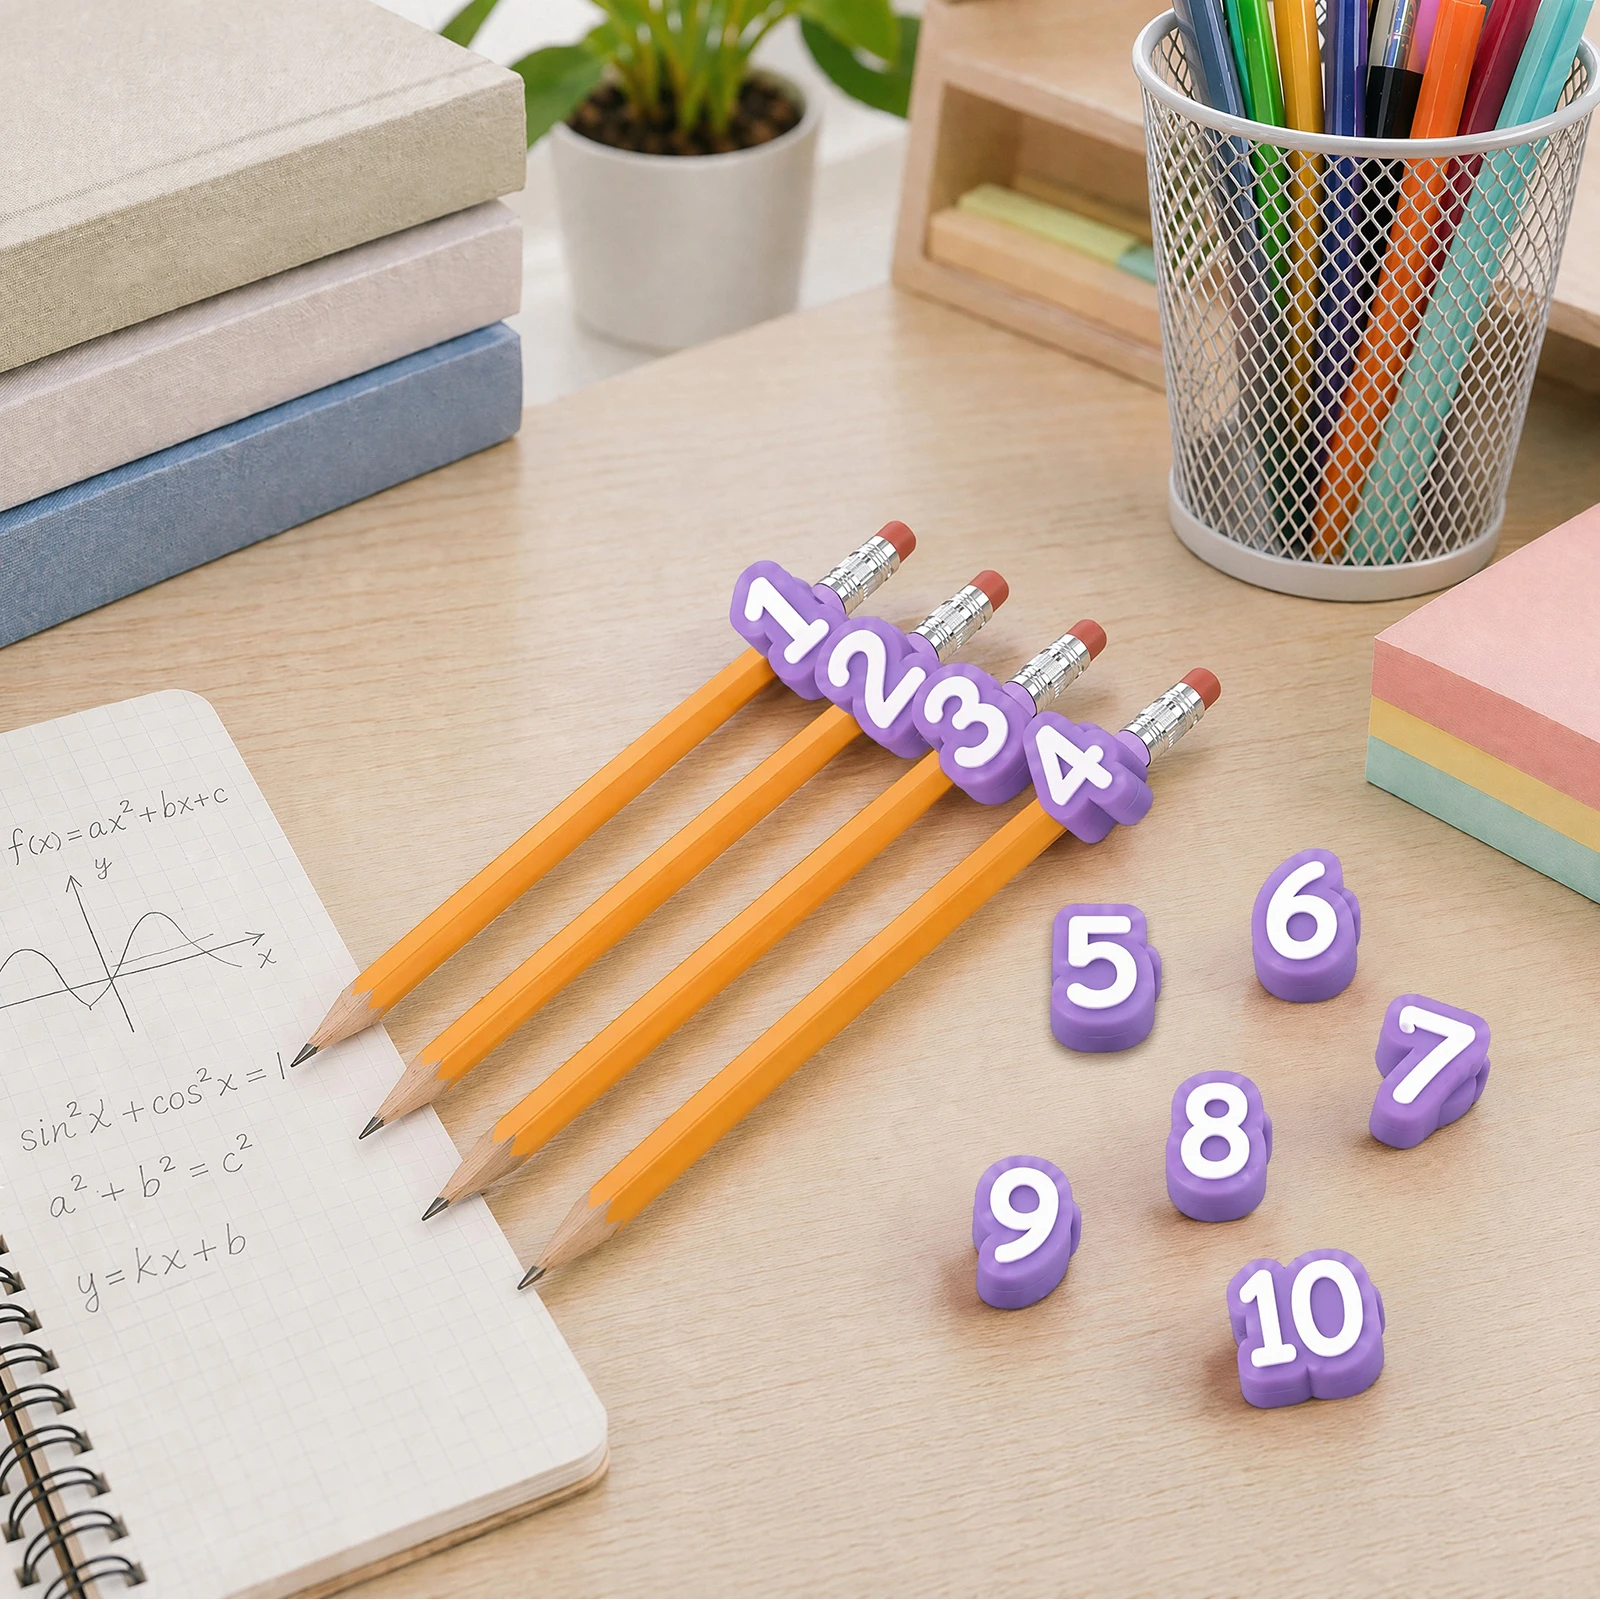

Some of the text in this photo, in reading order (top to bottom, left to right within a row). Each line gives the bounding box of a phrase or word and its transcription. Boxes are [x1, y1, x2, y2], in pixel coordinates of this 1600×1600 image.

[745, 577, 829, 663] 1
[828, 630, 926, 728] 2
[924, 676, 1007, 767] 3
[1036, 726, 1112, 805] 4
[94, 858, 113, 880] y
[1266, 862, 1337, 959] 6
[257, 947, 277, 969] x
[1067, 916, 1137, 1008] 5
[1393, 1006, 1475, 1103] 7
[1181, 1083, 1249, 1178] 8
[990, 1167, 1058, 1262] 9
[1240, 1260, 1363, 1367] 10
